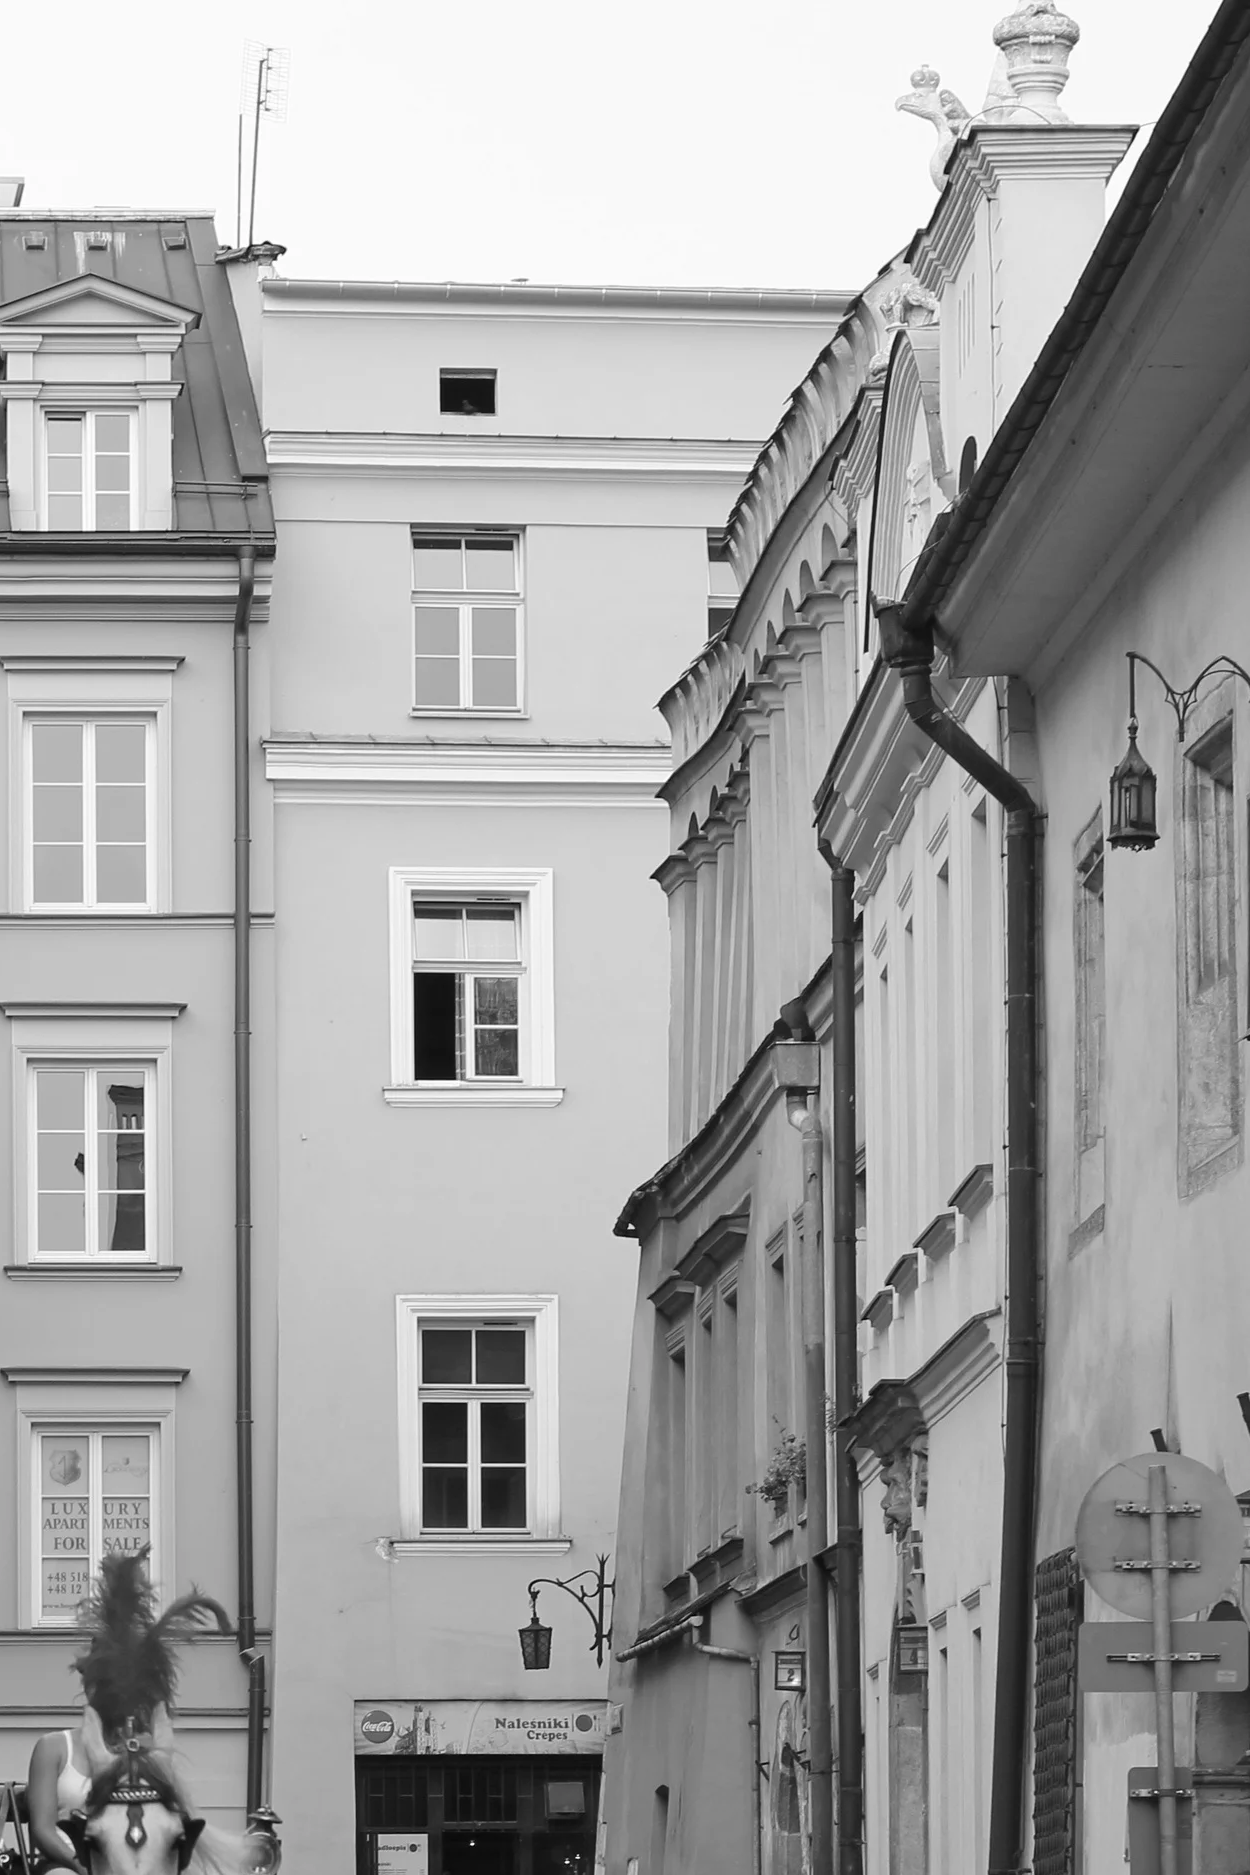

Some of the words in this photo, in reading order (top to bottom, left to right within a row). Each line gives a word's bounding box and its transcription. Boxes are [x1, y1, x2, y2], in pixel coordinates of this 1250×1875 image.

[54, 1537, 87, 1550] FOR
[104, 1537, 142, 1550] SALE
[47, 1572, 67, 1582] +48
[70, 1572, 89, 1582] 518
[47, 1584, 67, 1594] +48
[71, 1584, 82, 1594] 12
[787, 1668, 795, 1682] 2
[494, 1717, 570, 1729] Naleśniki
